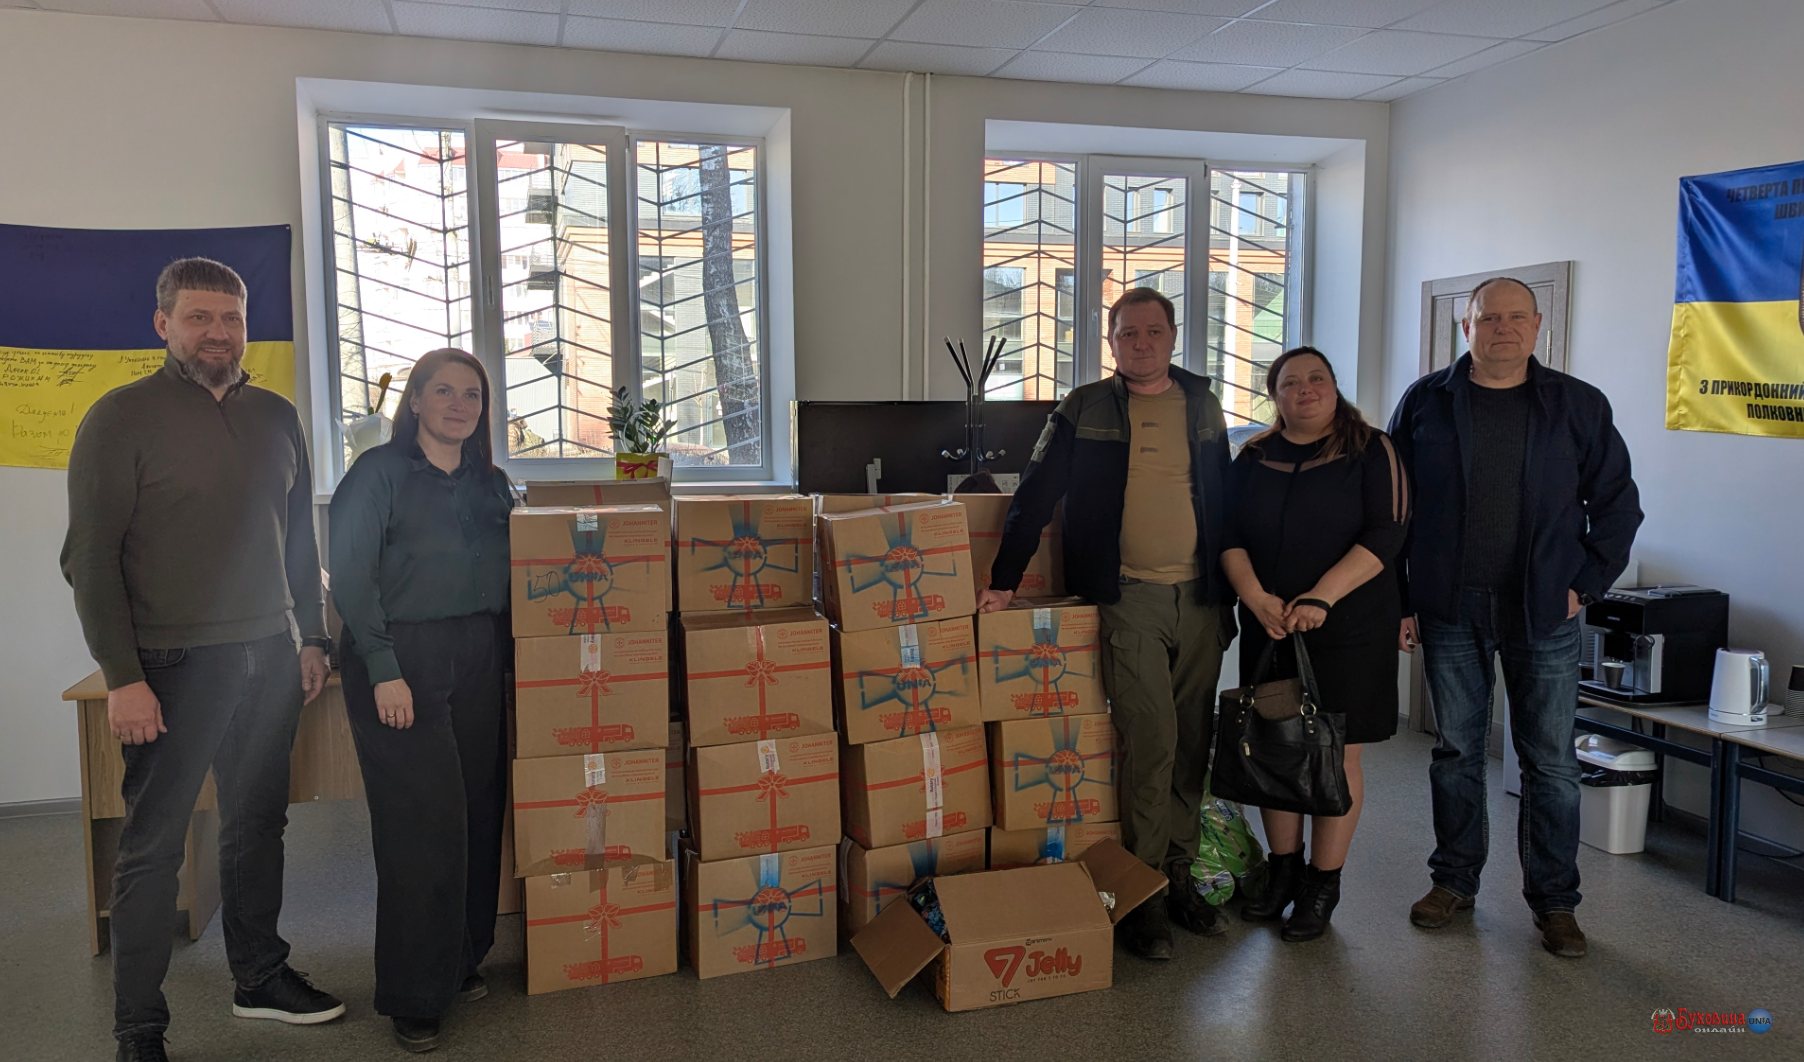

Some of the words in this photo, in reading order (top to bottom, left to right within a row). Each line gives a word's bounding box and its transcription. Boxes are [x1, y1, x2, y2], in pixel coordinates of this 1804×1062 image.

[1727, 180, 1788, 203] ЧЕТВЕРТА
[1747, 403, 1804, 422] ПОЛКОВН
[622, 519, 658, 527] JOHANNITER
[533, 570, 560, 603] 50
[789, 628, 823, 636] JOHANNITER
[627, 638, 662, 646] JOHANNITER
[1026, 947, 1082, 977] Jelly
[989, 987, 1021, 1002] STICK
